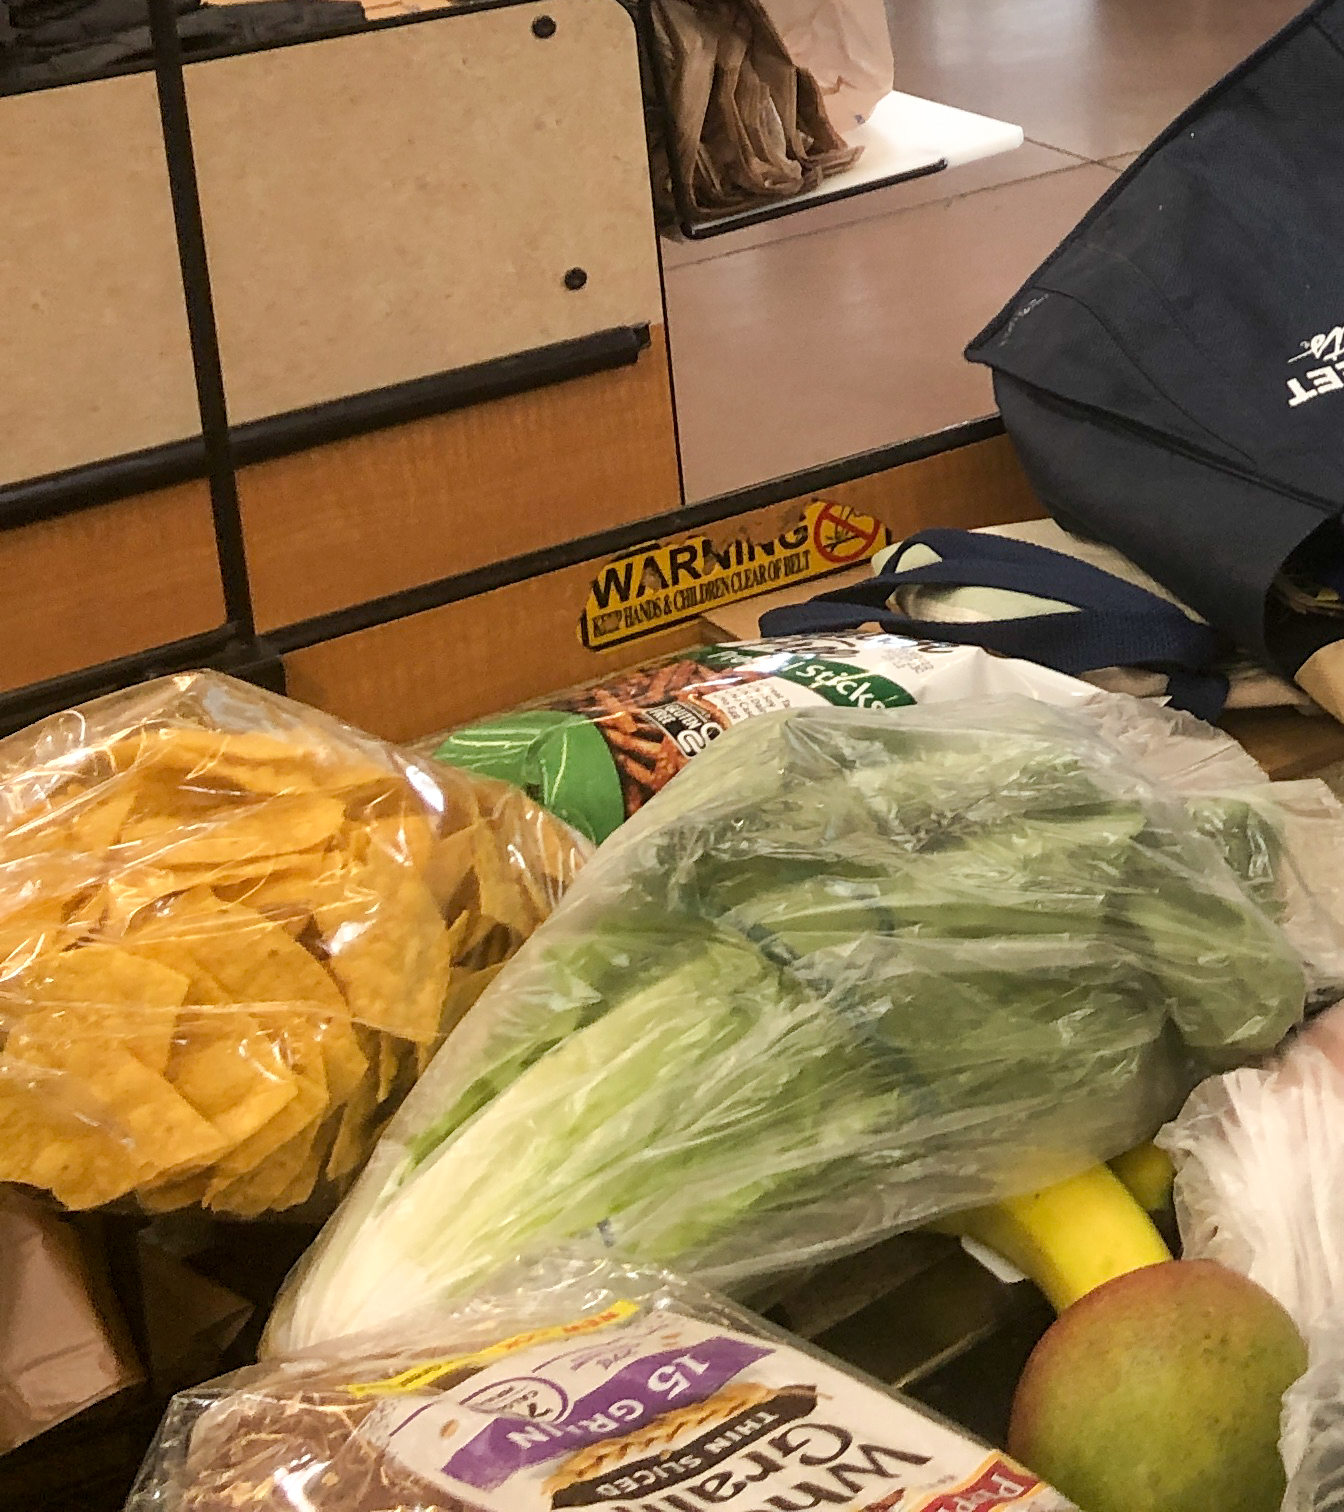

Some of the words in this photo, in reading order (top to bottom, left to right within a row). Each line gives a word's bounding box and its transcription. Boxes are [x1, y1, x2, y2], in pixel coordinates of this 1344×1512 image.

[624, 598, 662, 628] HANDS
[673, 576, 731, 612] CHILDREN
[731, 563, 767, 594] CLEAR
[647, 1353, 711, 1401] 15
[703, 1411, 779, 1454] THIN
[596, 1453, 703, 1497] SLICED
